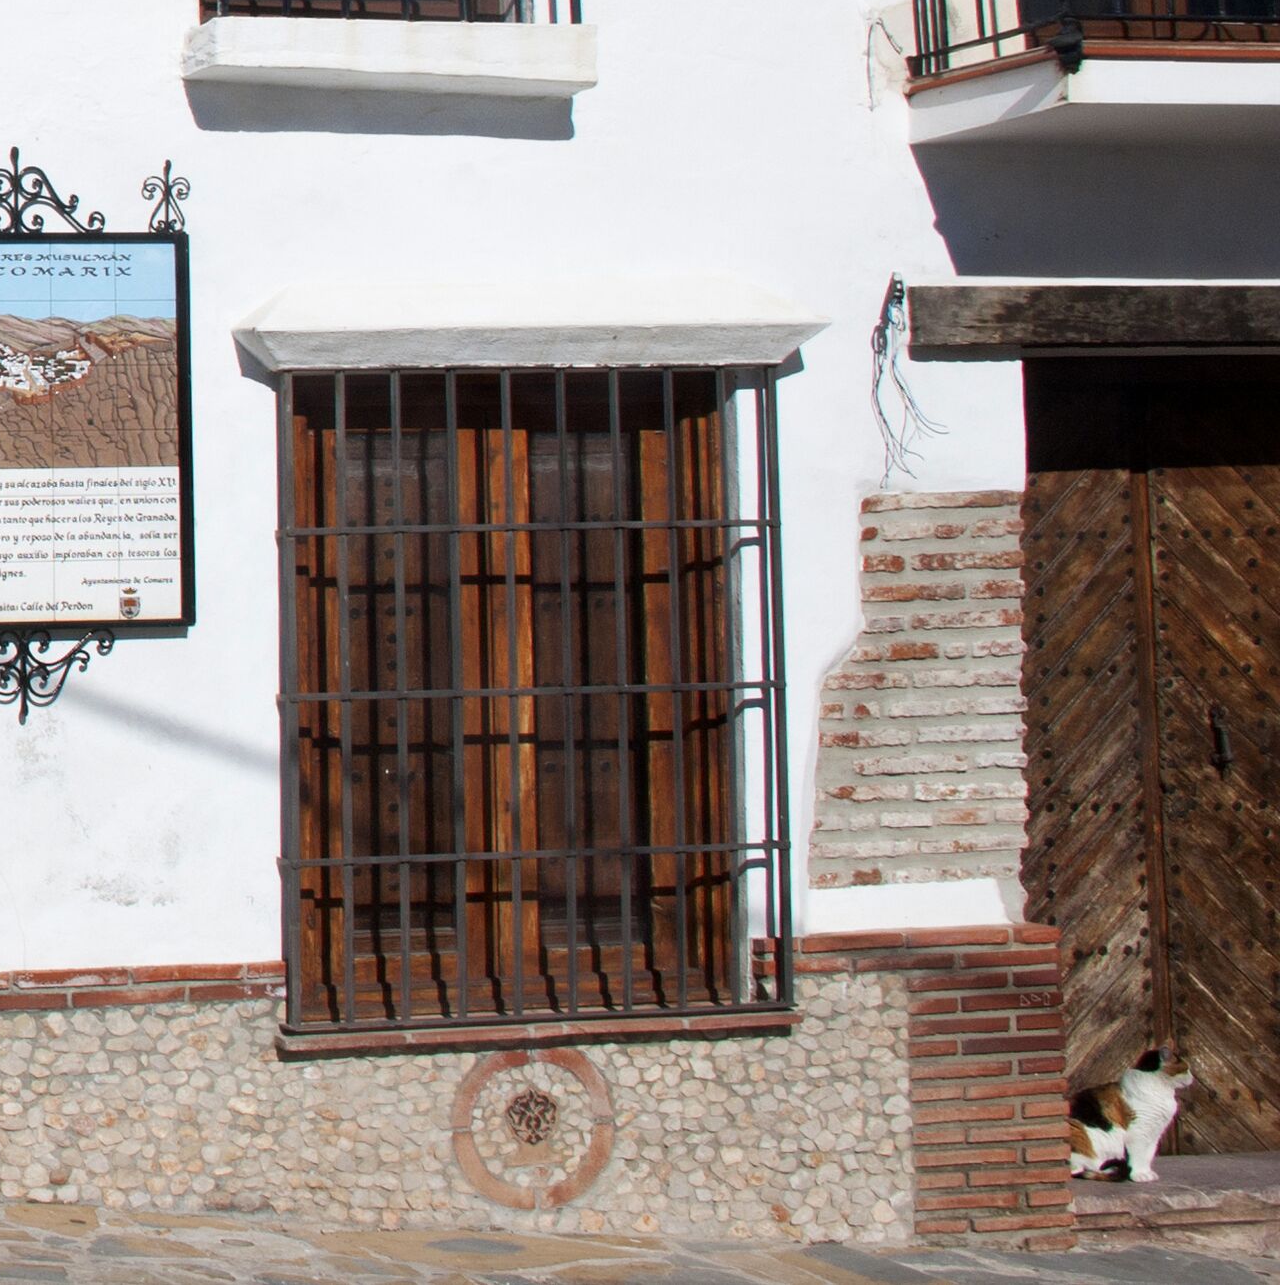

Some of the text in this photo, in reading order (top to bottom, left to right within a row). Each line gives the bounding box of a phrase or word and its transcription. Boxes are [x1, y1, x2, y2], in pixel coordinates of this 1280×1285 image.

[17, 479, 58, 488] alcazaba
[59, 478, 84, 488] hasta
[85, 478, 117, 491] finales
[119, 478, 132, 487] del
[135, 478, 157, 491] siglo
[20, 497, 65, 510] poderosos
[120, 497, 131, 505] en
[160, 496, 177, 504] con
[3, 516, 27, 524] tanto
[28, 516, 44, 527] que
[45, 514, 70, 524] hacer
[78, 514, 92, 523] los
[93, 513, 122, 526] Reyes
[124, 513, 134, 522] de
[136, 513, 177, 522] Granada.
[22, 535, 52, 546] reposo
[54, 532, 64, 541] de
[67, 531, 75, 540] la
[78, 531, 135, 541] abundancia,
[17, 550, 49, 559] auxilio
[52, 549, 103, 563] imploraban
[106, 550, 124, 558] con
[127, 549, 160, 557] tesoros
[163, 548, 177, 557] los
[81, 576, 174, 587] Ayuntamiento de Comares
[20, 601, 43, 612] Calle
[45, 601, 59, 611] del
